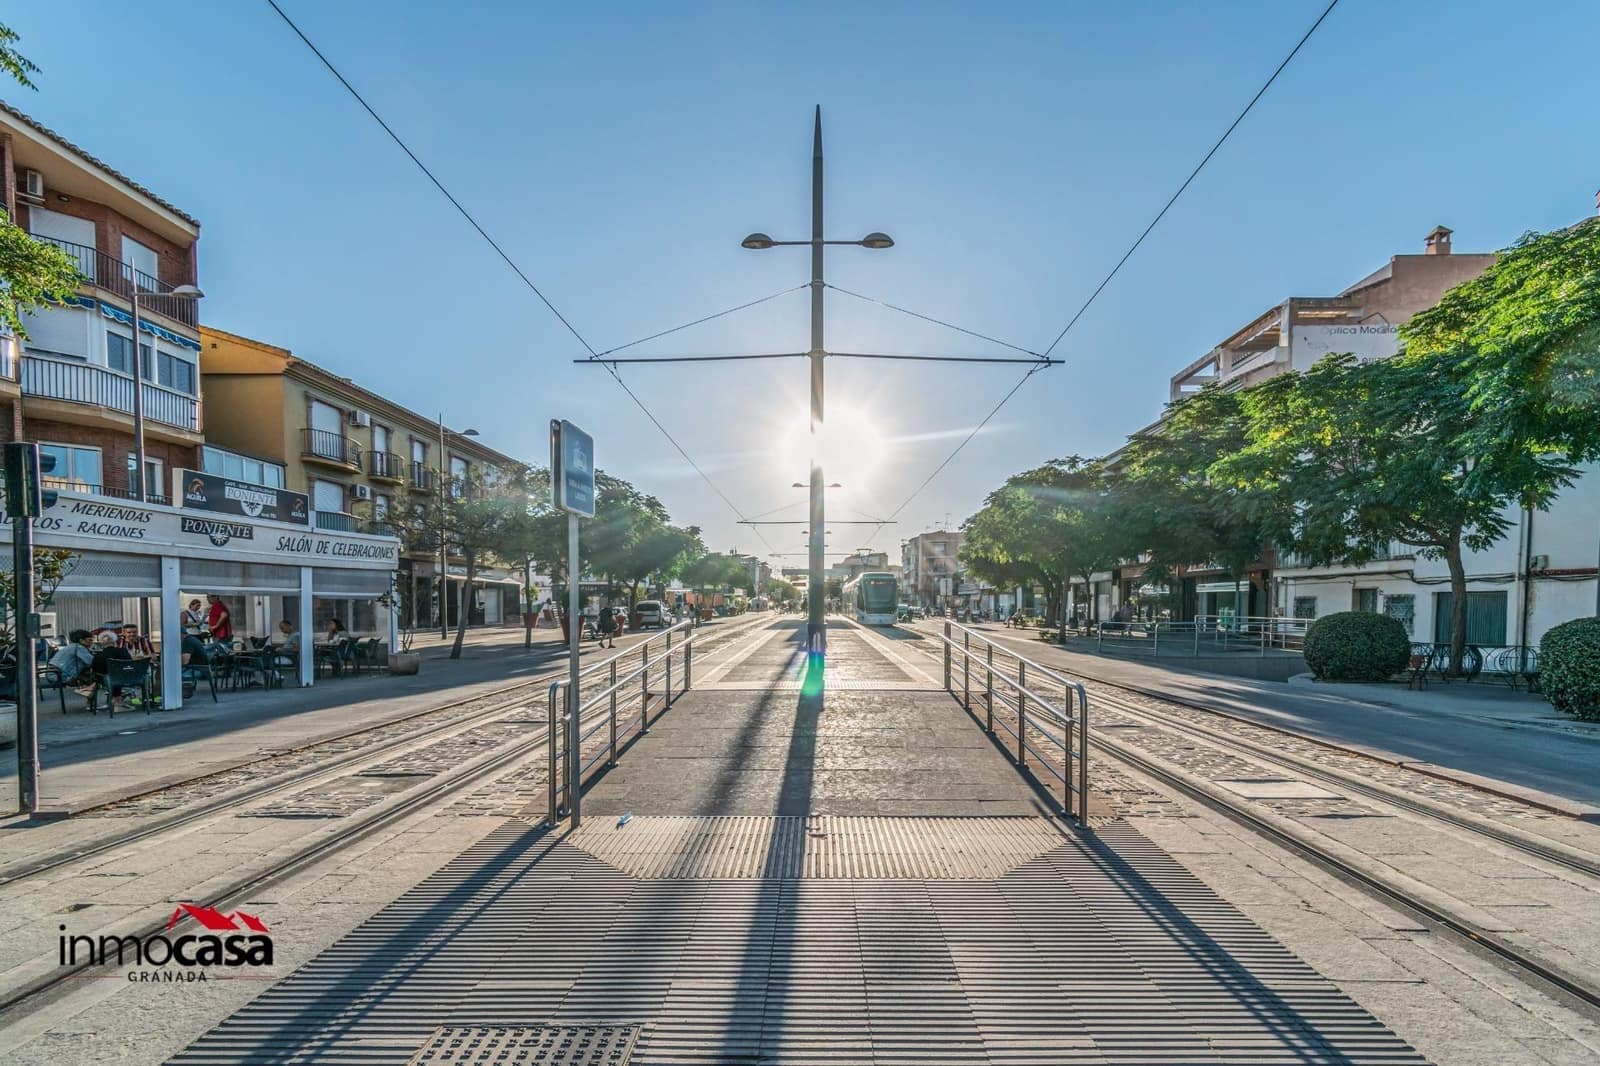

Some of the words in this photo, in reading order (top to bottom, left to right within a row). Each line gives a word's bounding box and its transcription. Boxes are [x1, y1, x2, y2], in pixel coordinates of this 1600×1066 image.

[226, 487, 277, 505] PONIENTE
[71, 502, 153, 523] MERIENDAS
[77, 521, 147, 539] RACIONES
[184, 519, 251, 537] PONIENTE
[276, 535, 313, 553] SALÓN
[316, 540, 330, 554] DE
[332, 542, 395, 559] CELEBRACIONES
